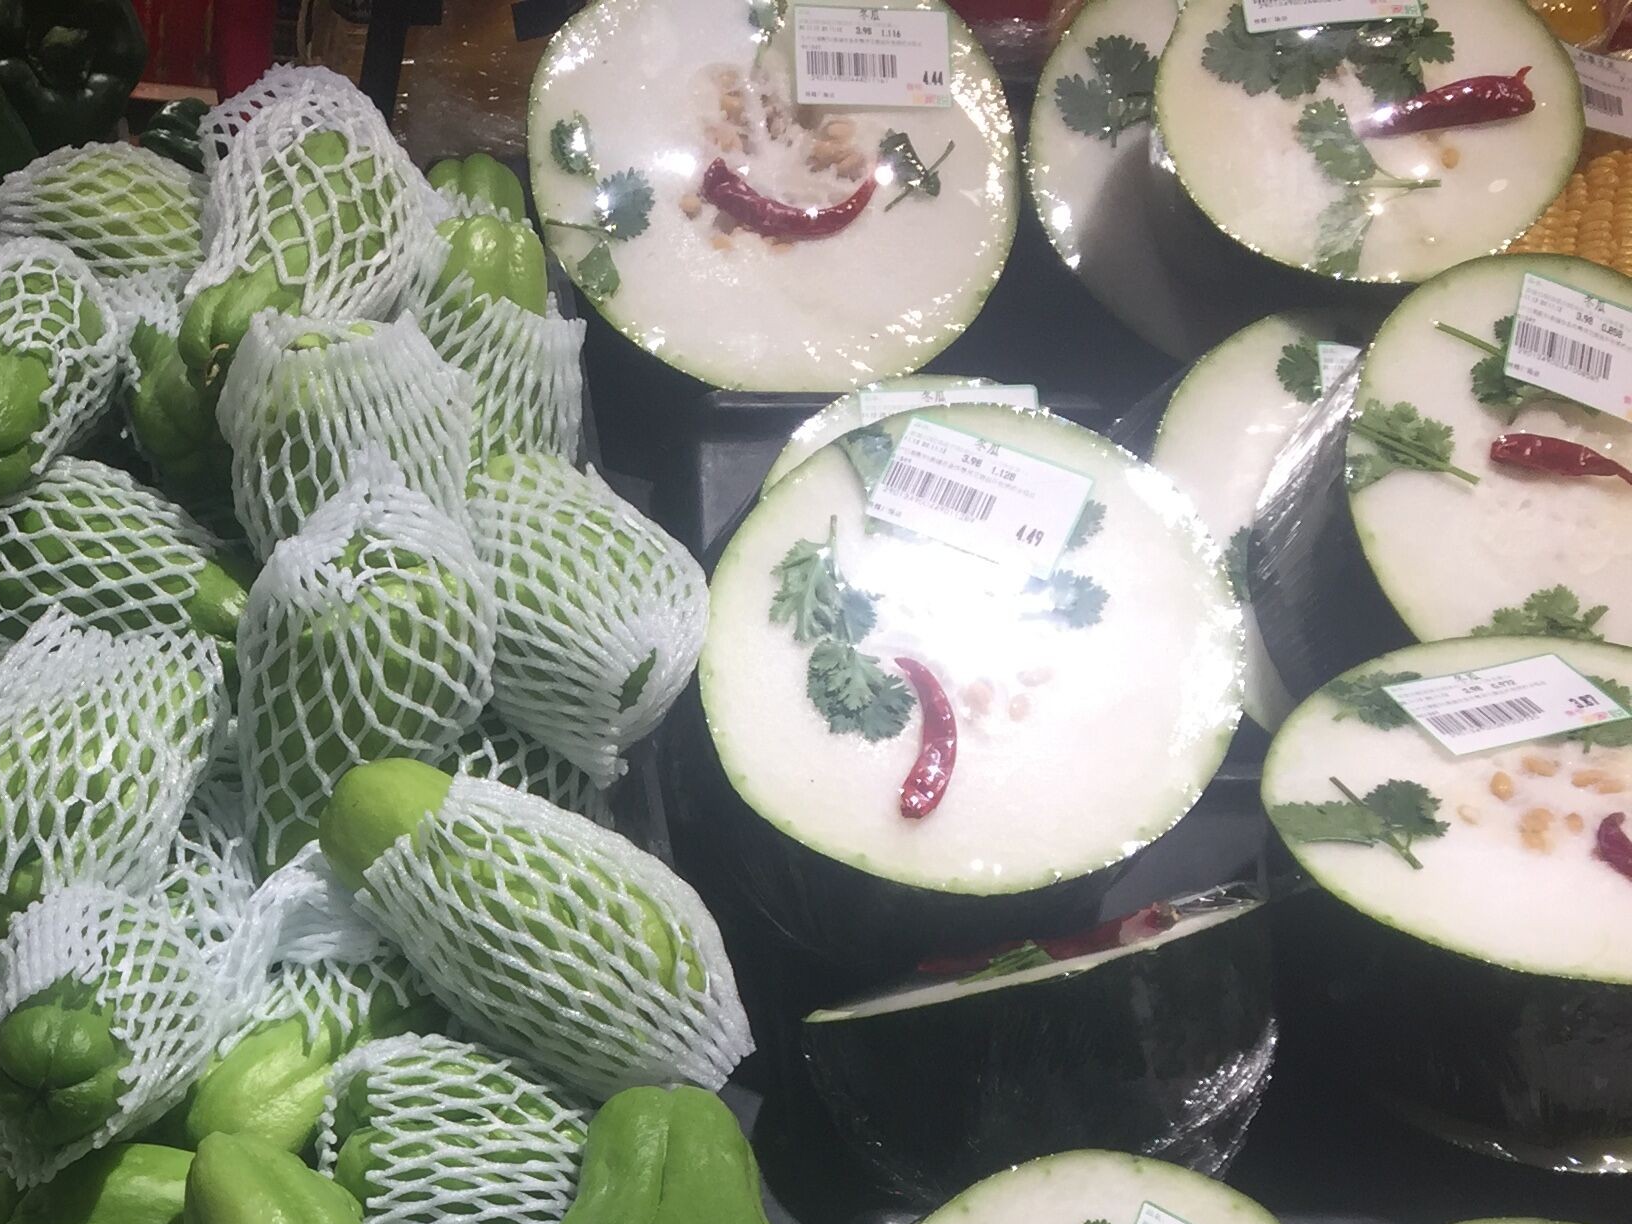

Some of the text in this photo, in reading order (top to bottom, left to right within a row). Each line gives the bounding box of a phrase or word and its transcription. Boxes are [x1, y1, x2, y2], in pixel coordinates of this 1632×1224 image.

[881, 27, 901, 39] 1.116
[922, 71, 944, 86] 4.44
[1576, 311, 1594, 326] 3.98
[921, 389, 947, 403] 冬瓜
[974, 438, 1001, 457] 冬瓜
[961, 454, 983, 468] 3.98
[991, 466, 1017, 482] 1.128
[1015, 524, 1045, 547] 4.49
[1568, 693, 1600, 709] 3.87
